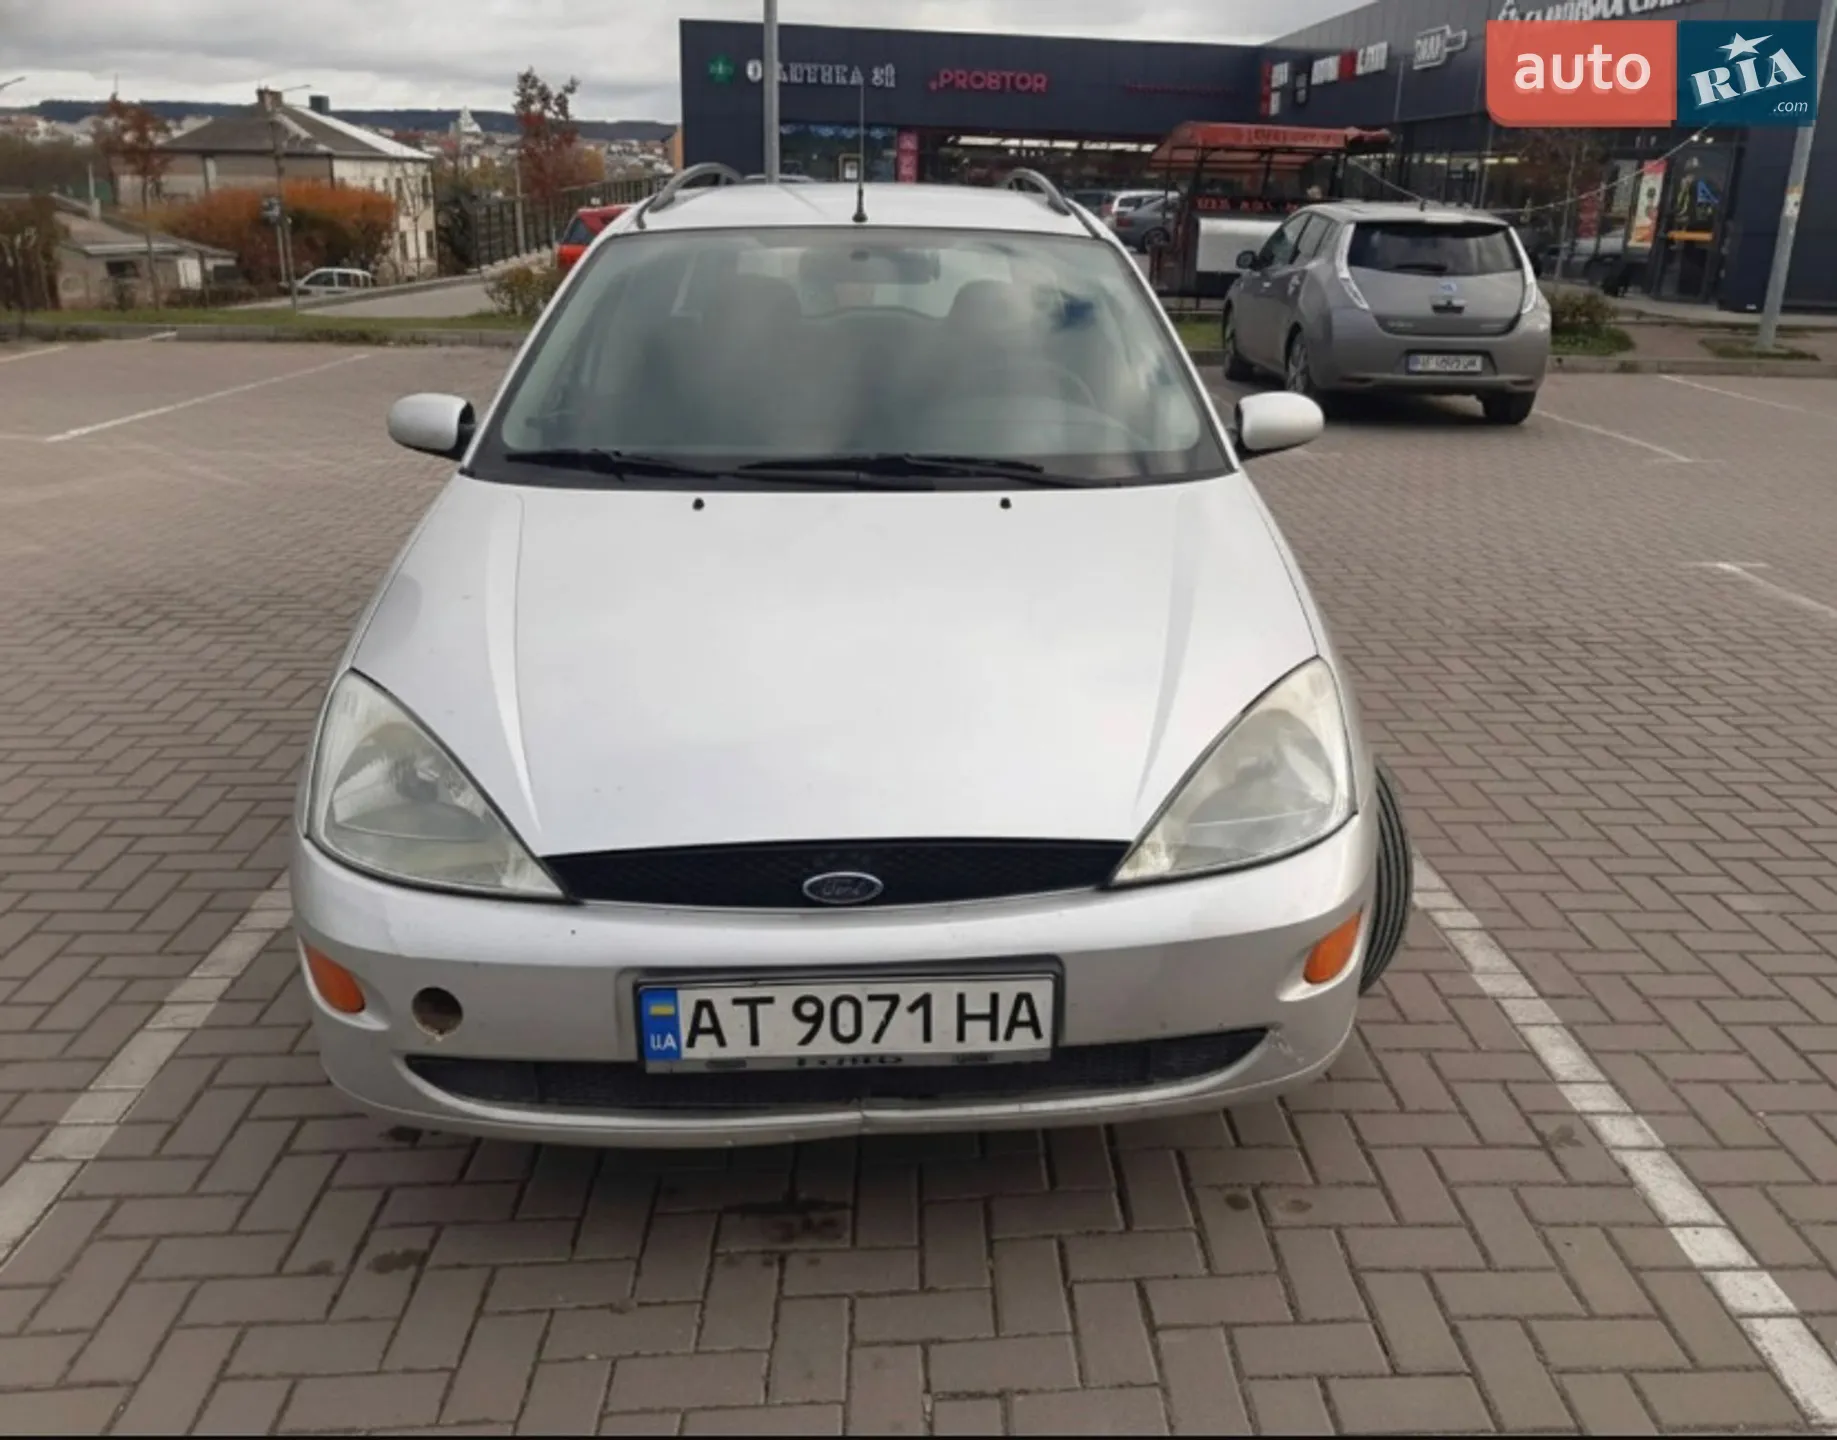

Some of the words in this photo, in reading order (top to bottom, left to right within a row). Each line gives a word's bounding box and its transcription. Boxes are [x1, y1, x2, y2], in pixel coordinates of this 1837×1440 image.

[686, 996, 775, 1049] AT
[791, 992, 934, 1046] 9071
[956, 990, 1045, 1043] HA
[650, 1033, 678, 1051] UA
